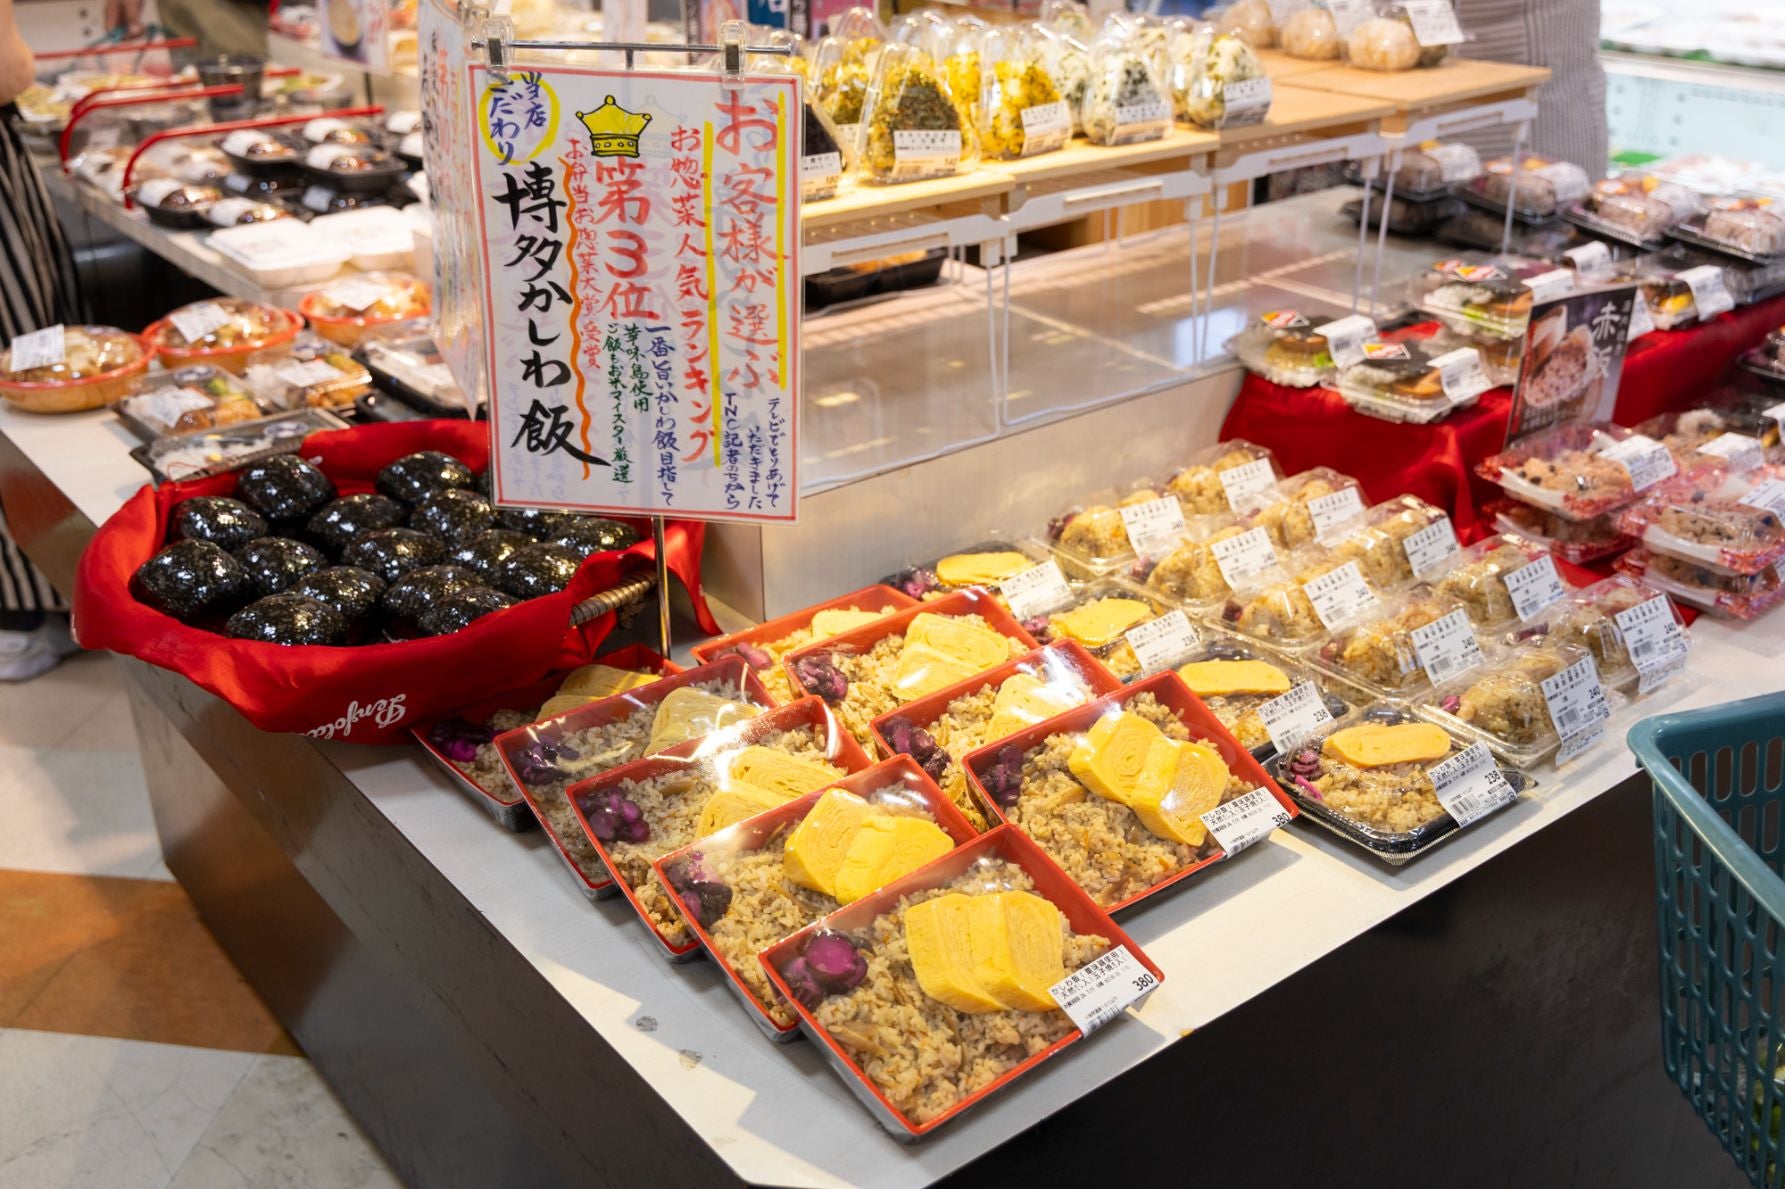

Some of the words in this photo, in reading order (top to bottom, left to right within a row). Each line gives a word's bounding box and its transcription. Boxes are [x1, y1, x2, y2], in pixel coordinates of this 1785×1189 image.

[489, 78, 523, 166] こだわり
[521, 71, 547, 130] 当店
[594, 155, 660, 320] 第3位
[714, 89, 789, 389] お客様が選ぶ
[491, 161, 612, 467] 博多かしわ飯
[670, 124, 715, 462] お惣菜人気ランキング
[624, 322, 654, 413] 華味鳥使用
[644, 325, 681, 506] 一番旨いかしわ飯目指して
[1461, 635, 1476, 649] 240
[1271, 812, 1291, 828] 380
[1484, 770, 1501, 785] 238
[1132, 973, 1154, 992] 380
